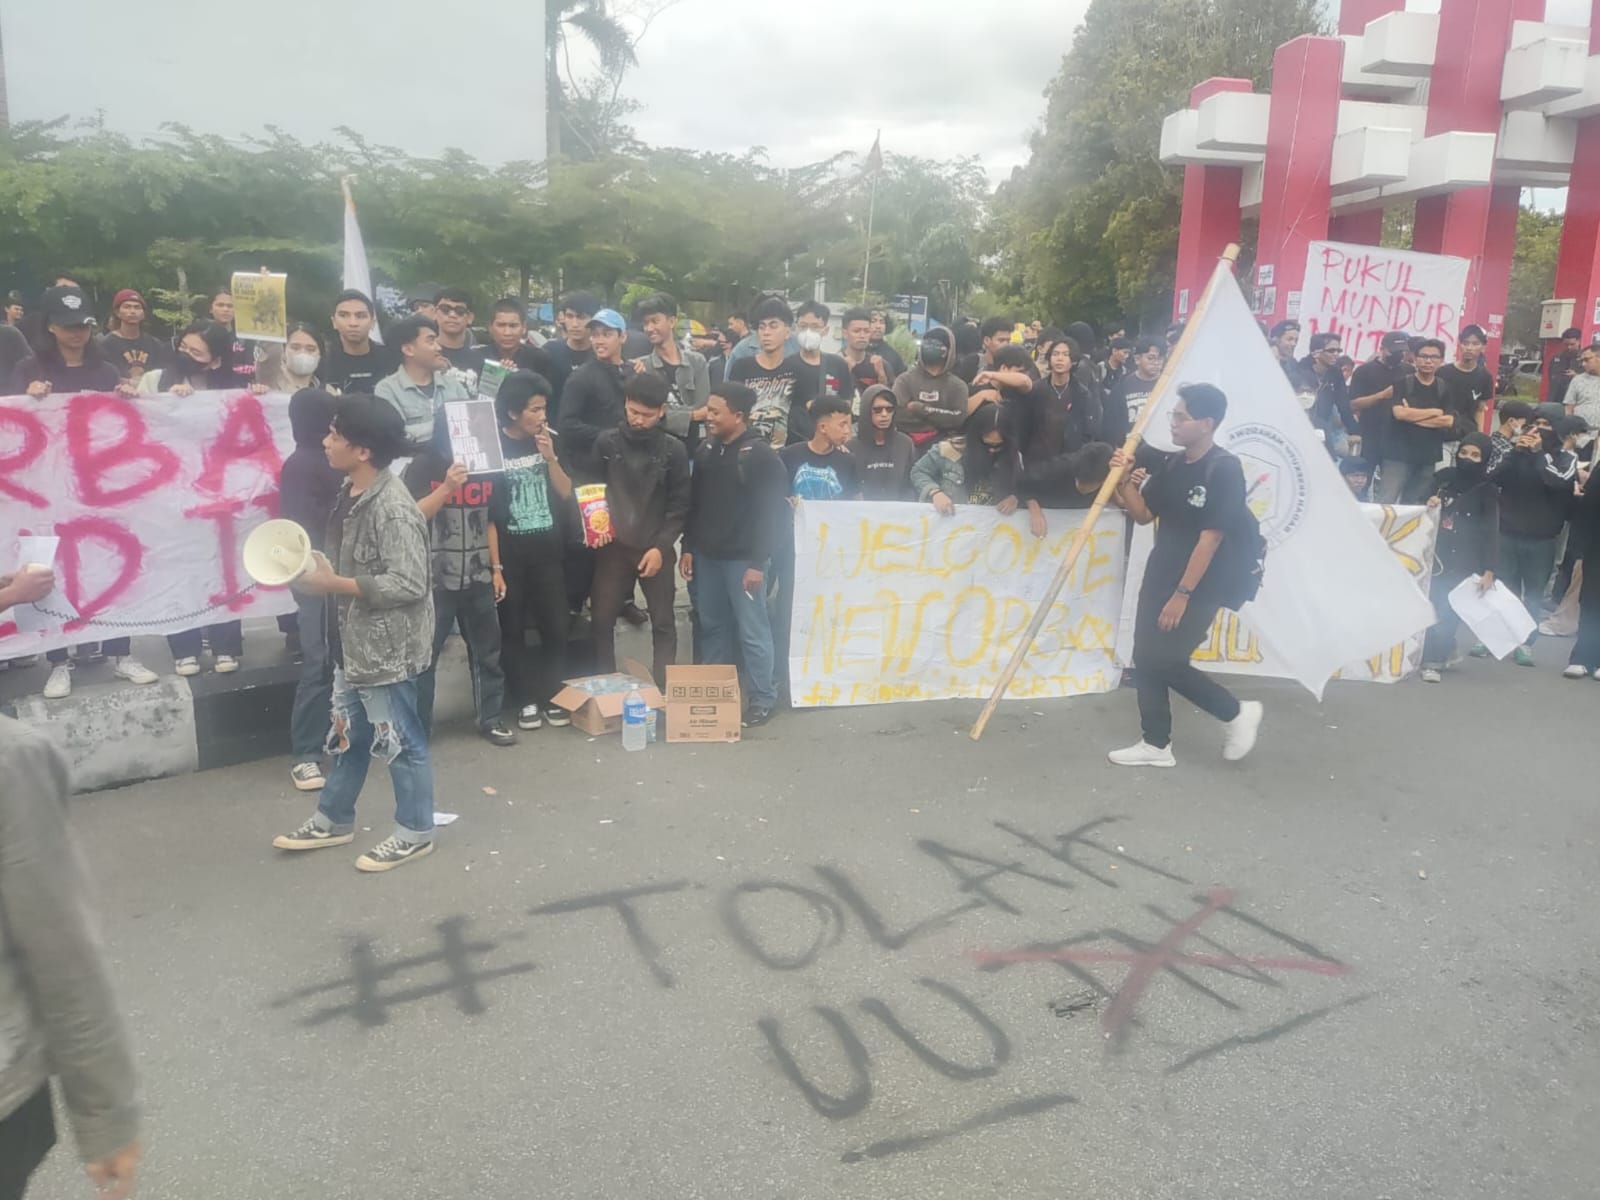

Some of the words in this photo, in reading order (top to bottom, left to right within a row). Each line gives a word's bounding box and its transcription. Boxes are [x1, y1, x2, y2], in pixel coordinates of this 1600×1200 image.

[1322, 247, 1426, 297] PUKUL
[1320, 286, 1455, 343] MUNDUR
[815, 514, 1119, 595] WELCOME
[757, 976, 1010, 1120] UU
